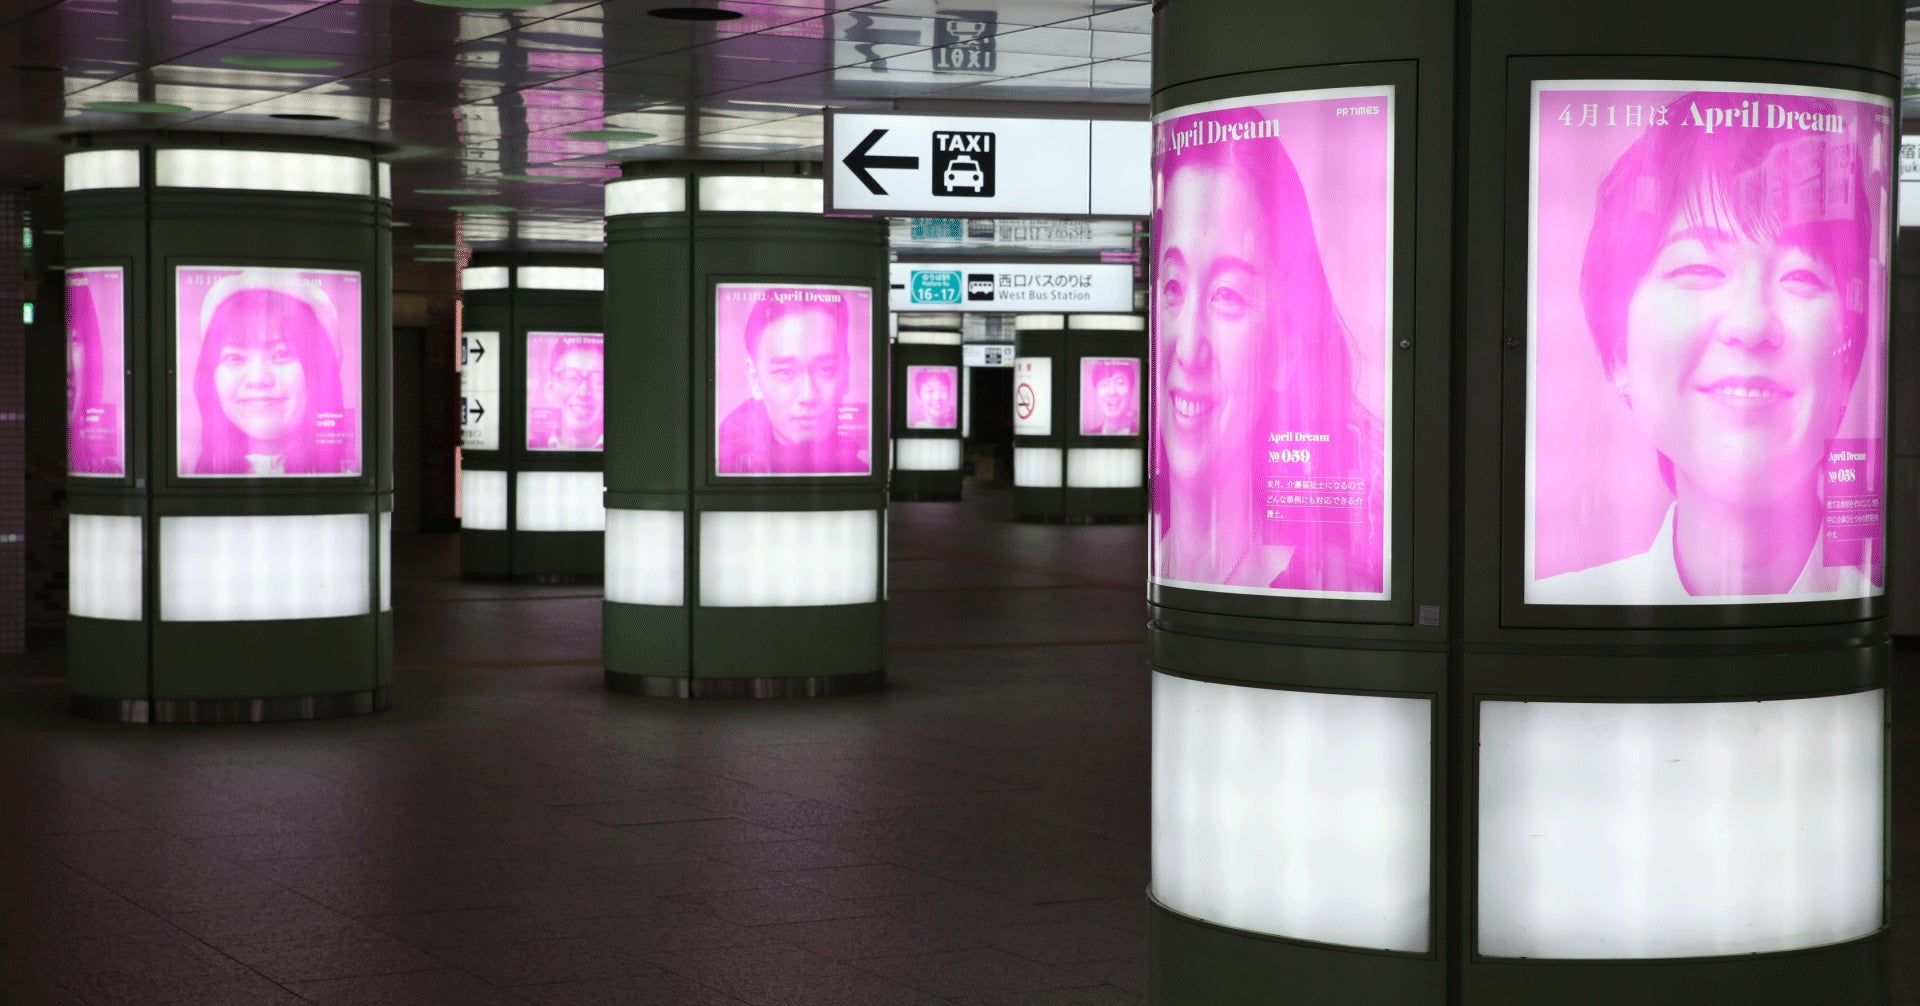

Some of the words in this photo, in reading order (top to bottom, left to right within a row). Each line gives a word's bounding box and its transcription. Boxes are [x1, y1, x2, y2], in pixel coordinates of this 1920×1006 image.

[1558, 102, 1669, 127] 4月1日は
[1681, 100, 1759, 133] April
[1766, 102, 1844, 133] Dream
[937, 134, 990, 152] TAXI
[1168, 120, 1204, 156] April
[1207, 119, 1280, 144] Dream
[998, 273, 1093, 289] 西口バスのりば
[771, 291, 803, 304] April
[805, 292, 841, 303] Dream
[998, 290, 1025, 300] West
[1029, 290, 1048, 300] Bus
[1051, 290, 1091, 300] Station
[1268, 432, 1293, 444] April
[1295, 432, 1330, 442] Dream
[1829, 451, 1846, 463] April
